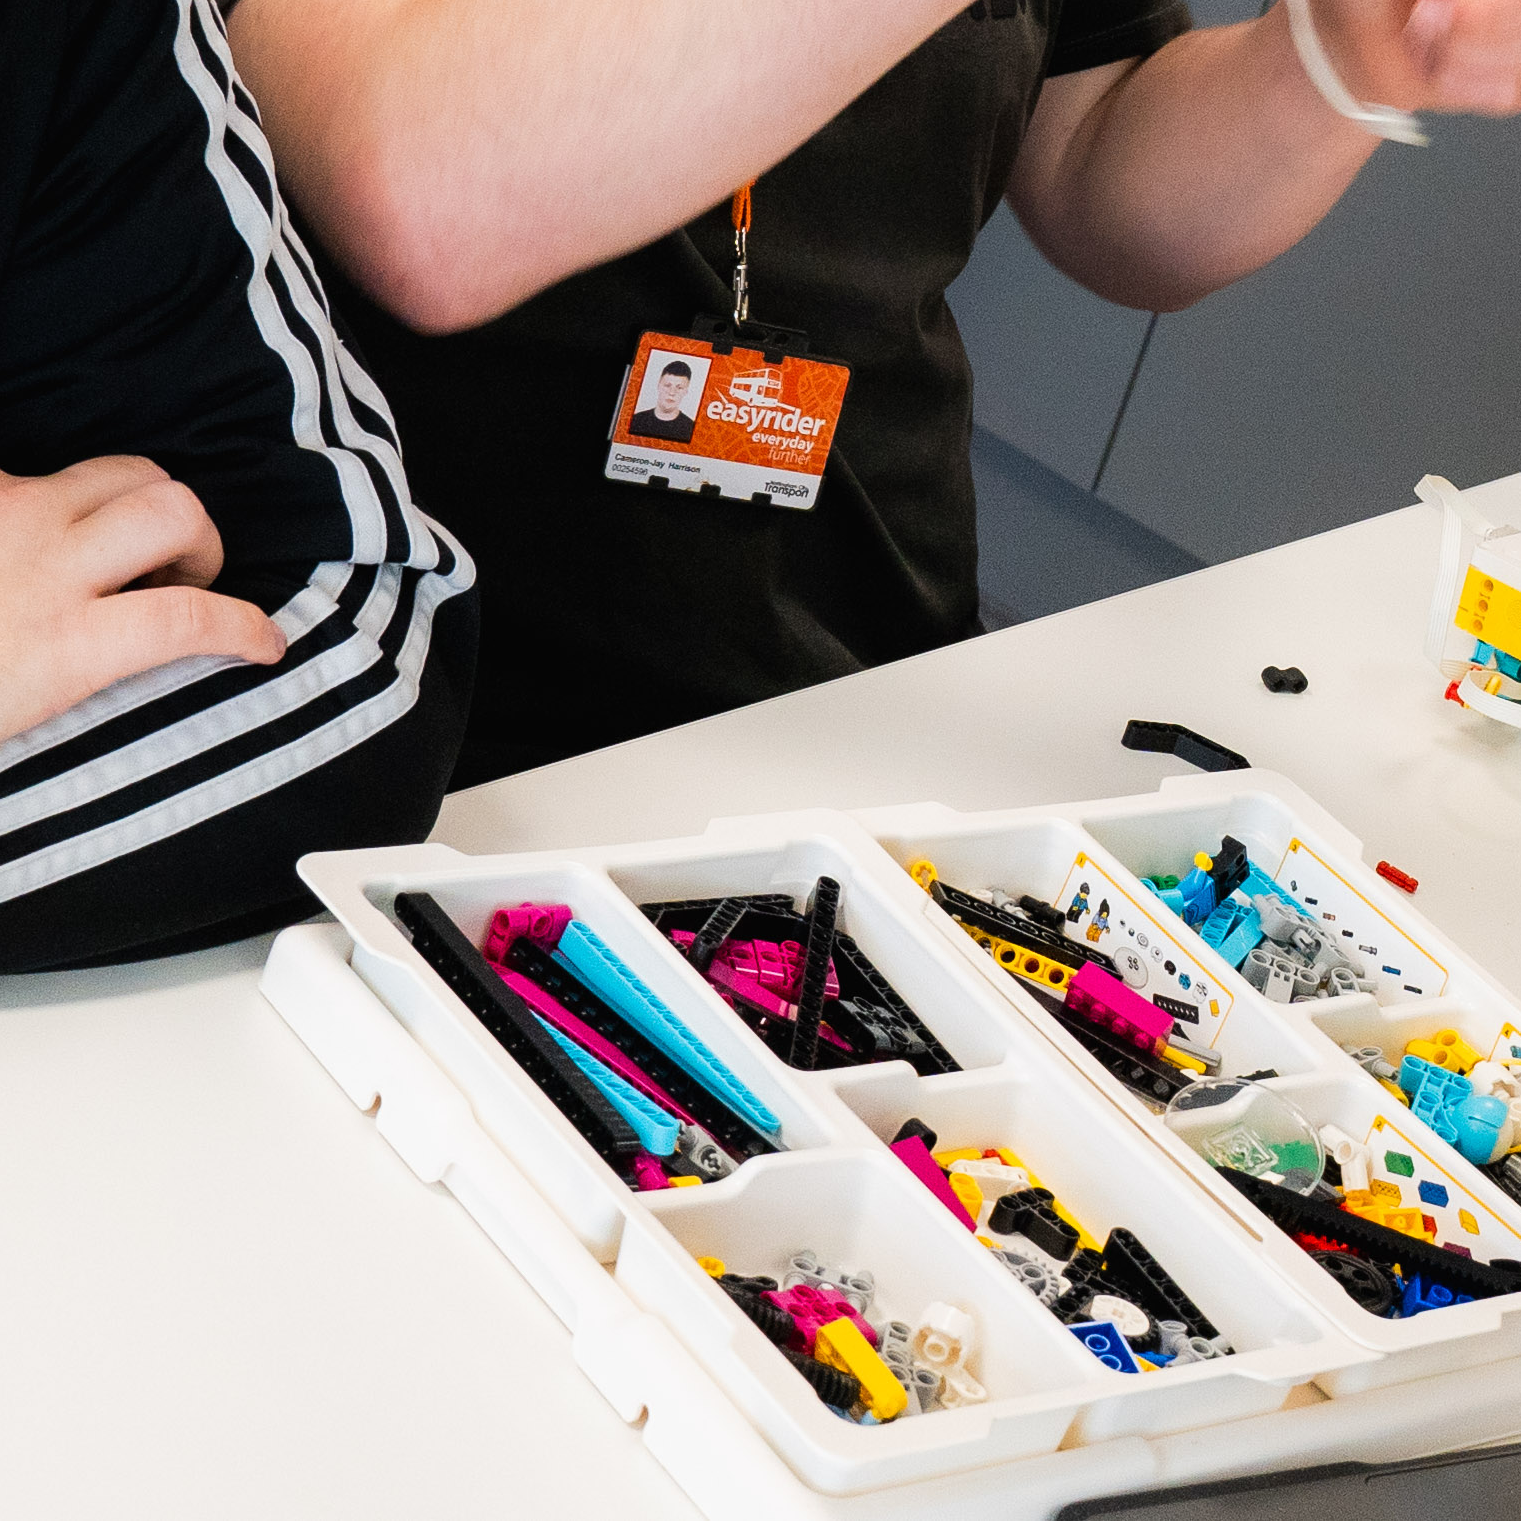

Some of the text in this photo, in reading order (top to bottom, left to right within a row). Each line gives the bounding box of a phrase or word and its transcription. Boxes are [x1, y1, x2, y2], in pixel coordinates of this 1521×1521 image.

[706, 400, 826, 437] easyrider
[751, 431, 815, 454] everyday
[767, 446, 812, 466] further
